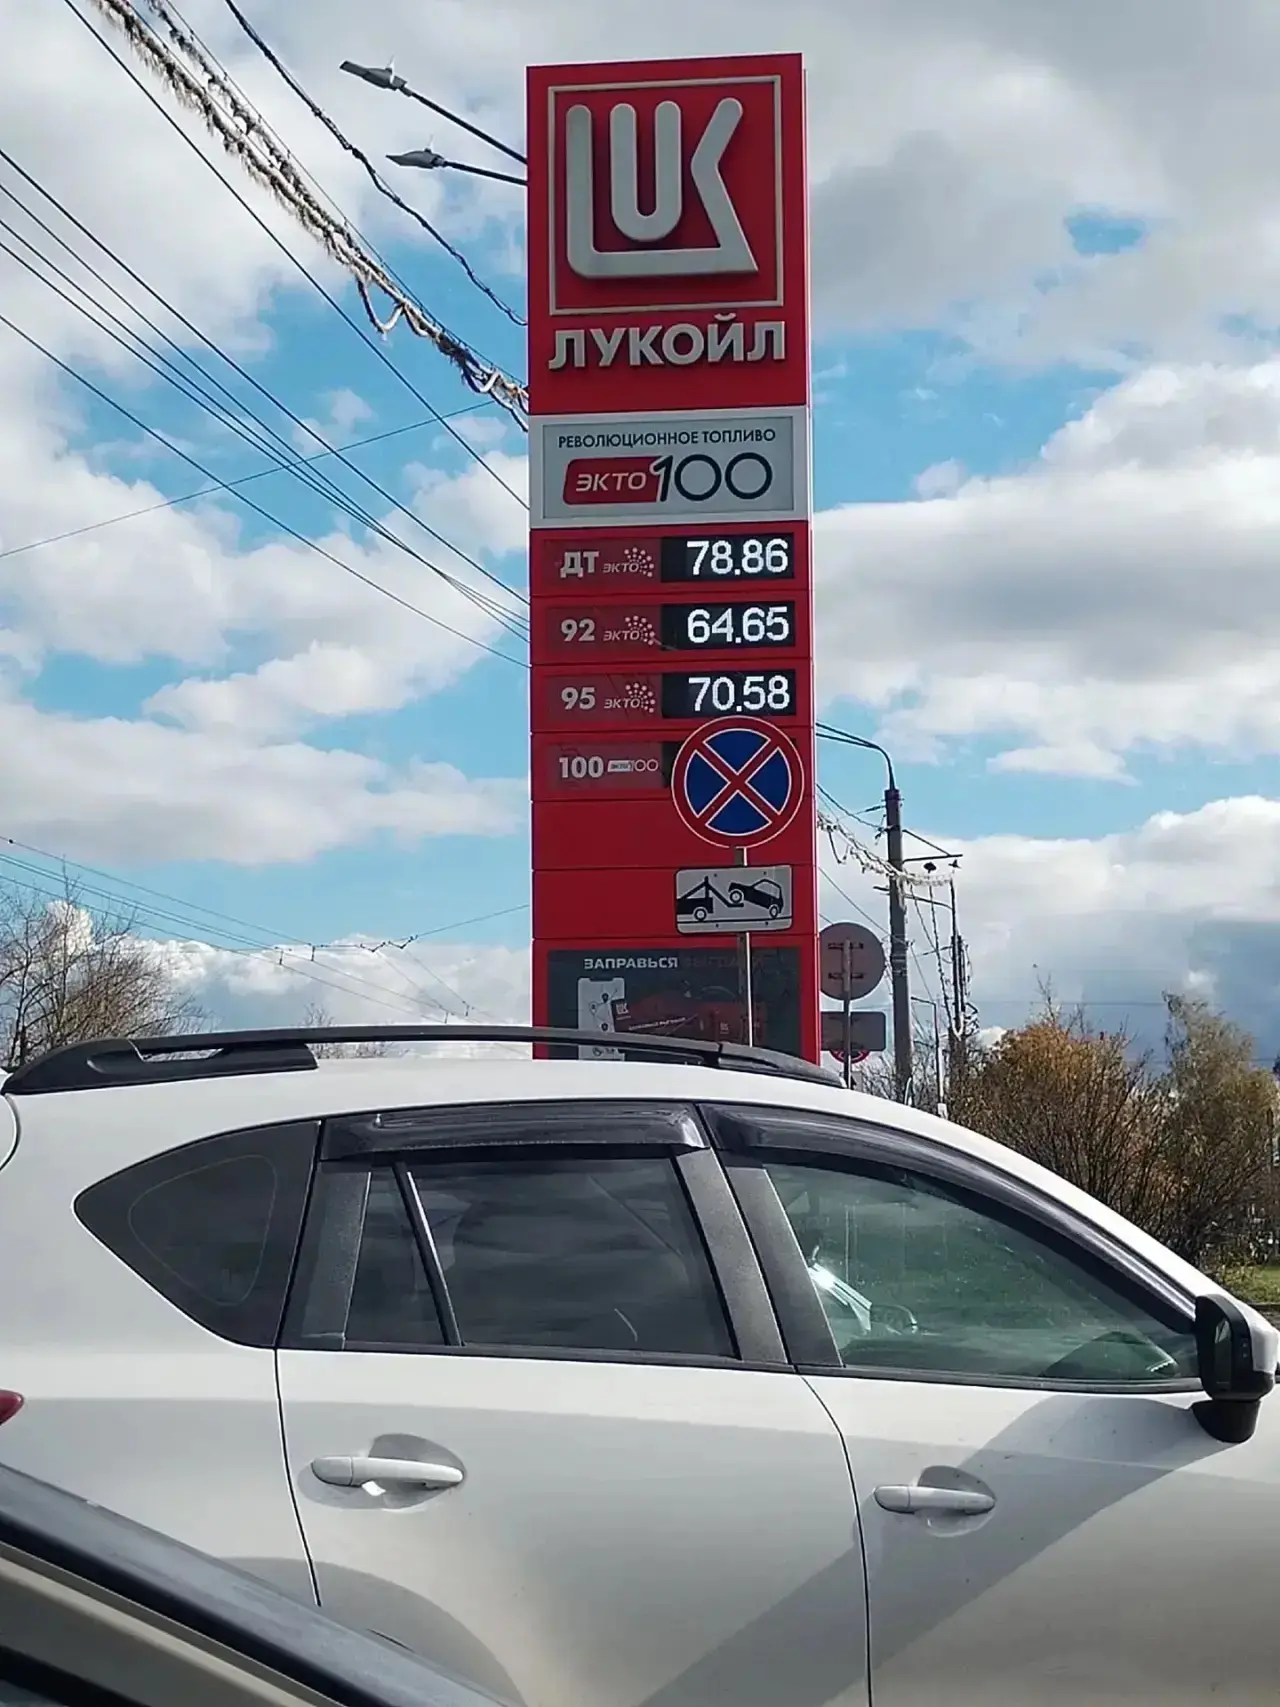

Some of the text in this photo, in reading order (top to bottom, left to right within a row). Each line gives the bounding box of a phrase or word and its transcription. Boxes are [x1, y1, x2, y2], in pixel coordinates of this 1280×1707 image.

[548, 312, 786, 370] ЛУКОЙЛ
[558, 428, 777, 449] РЕВОЛЮЦИОННОЕ ТОПЛИВО
[575, 452, 773, 502] ЭКТО 100
[560, 538, 789, 578] ДТ ЭКТО 78.86
[560, 606, 790, 644] 92 ЭКТО 64.65
[561, 675, 791, 713] 95 ЭКТО 70.58
[559, 756, 605, 779] 100
[584, 957, 679, 970] ЗАПРАВЬСЯ
